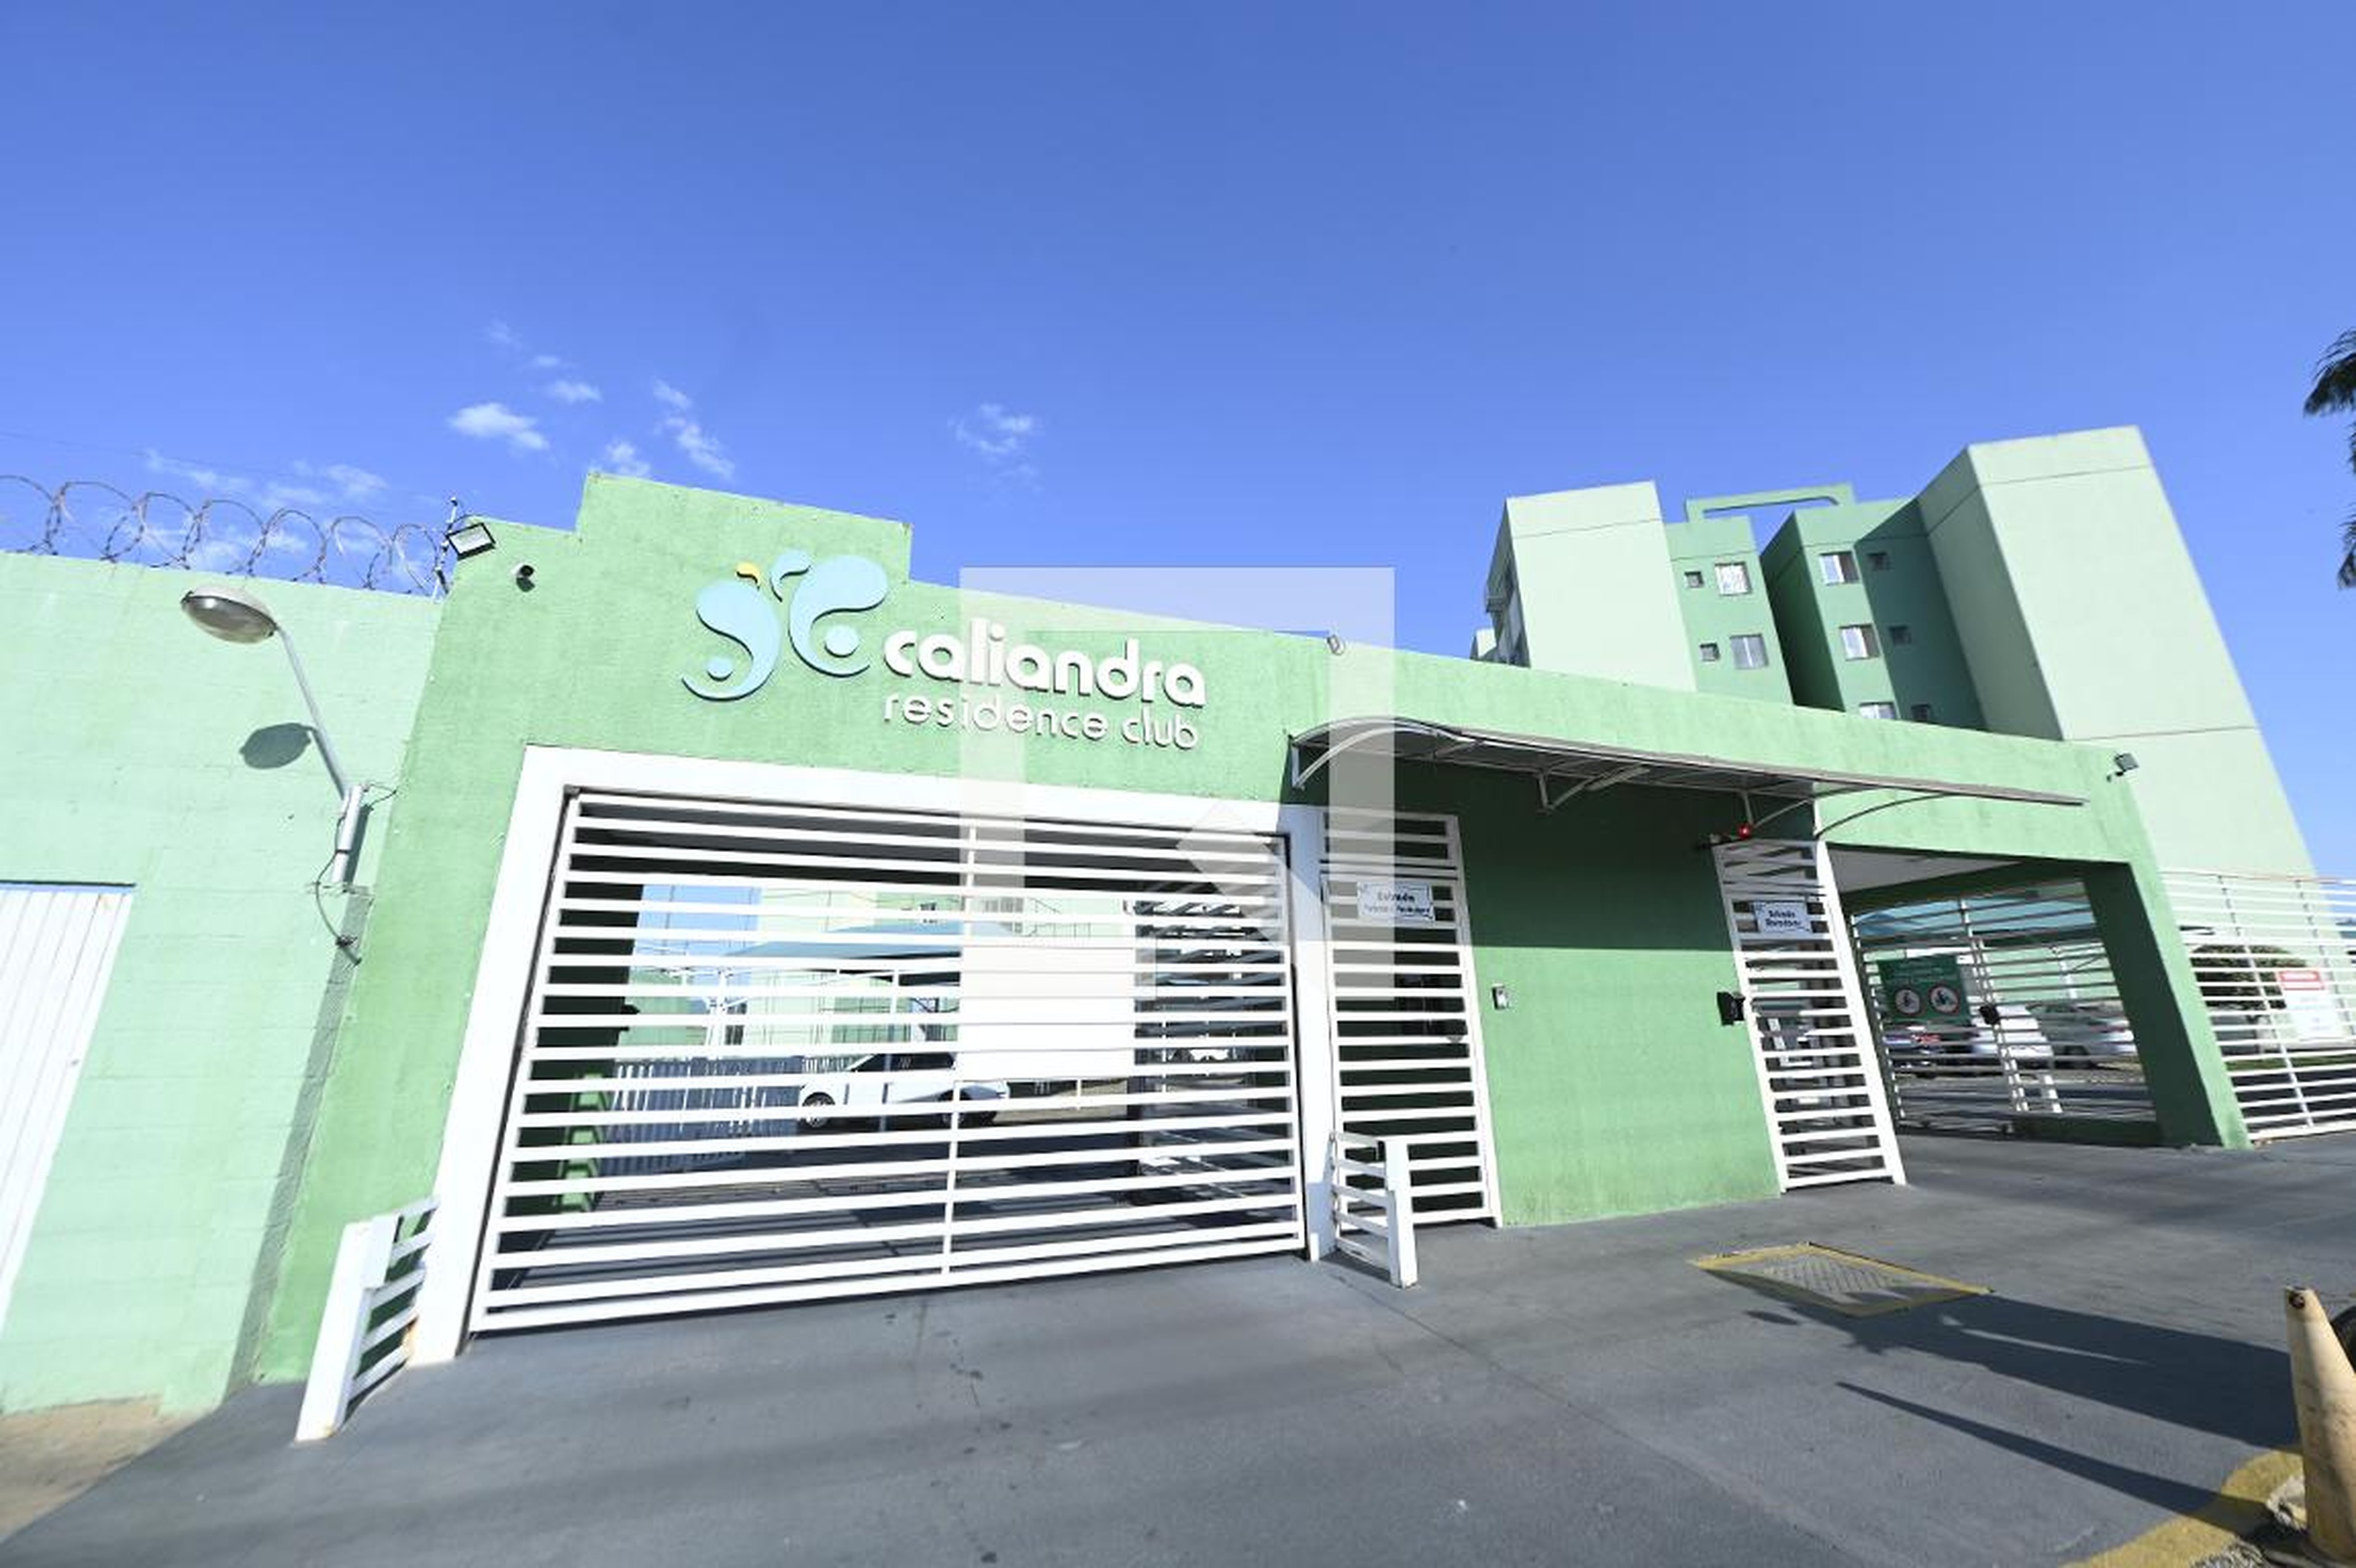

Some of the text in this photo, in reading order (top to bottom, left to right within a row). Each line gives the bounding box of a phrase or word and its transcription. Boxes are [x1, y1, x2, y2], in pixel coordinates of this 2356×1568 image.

[884, 618, 1206, 708] caliandra
[884, 694, 1198, 750] residence club
